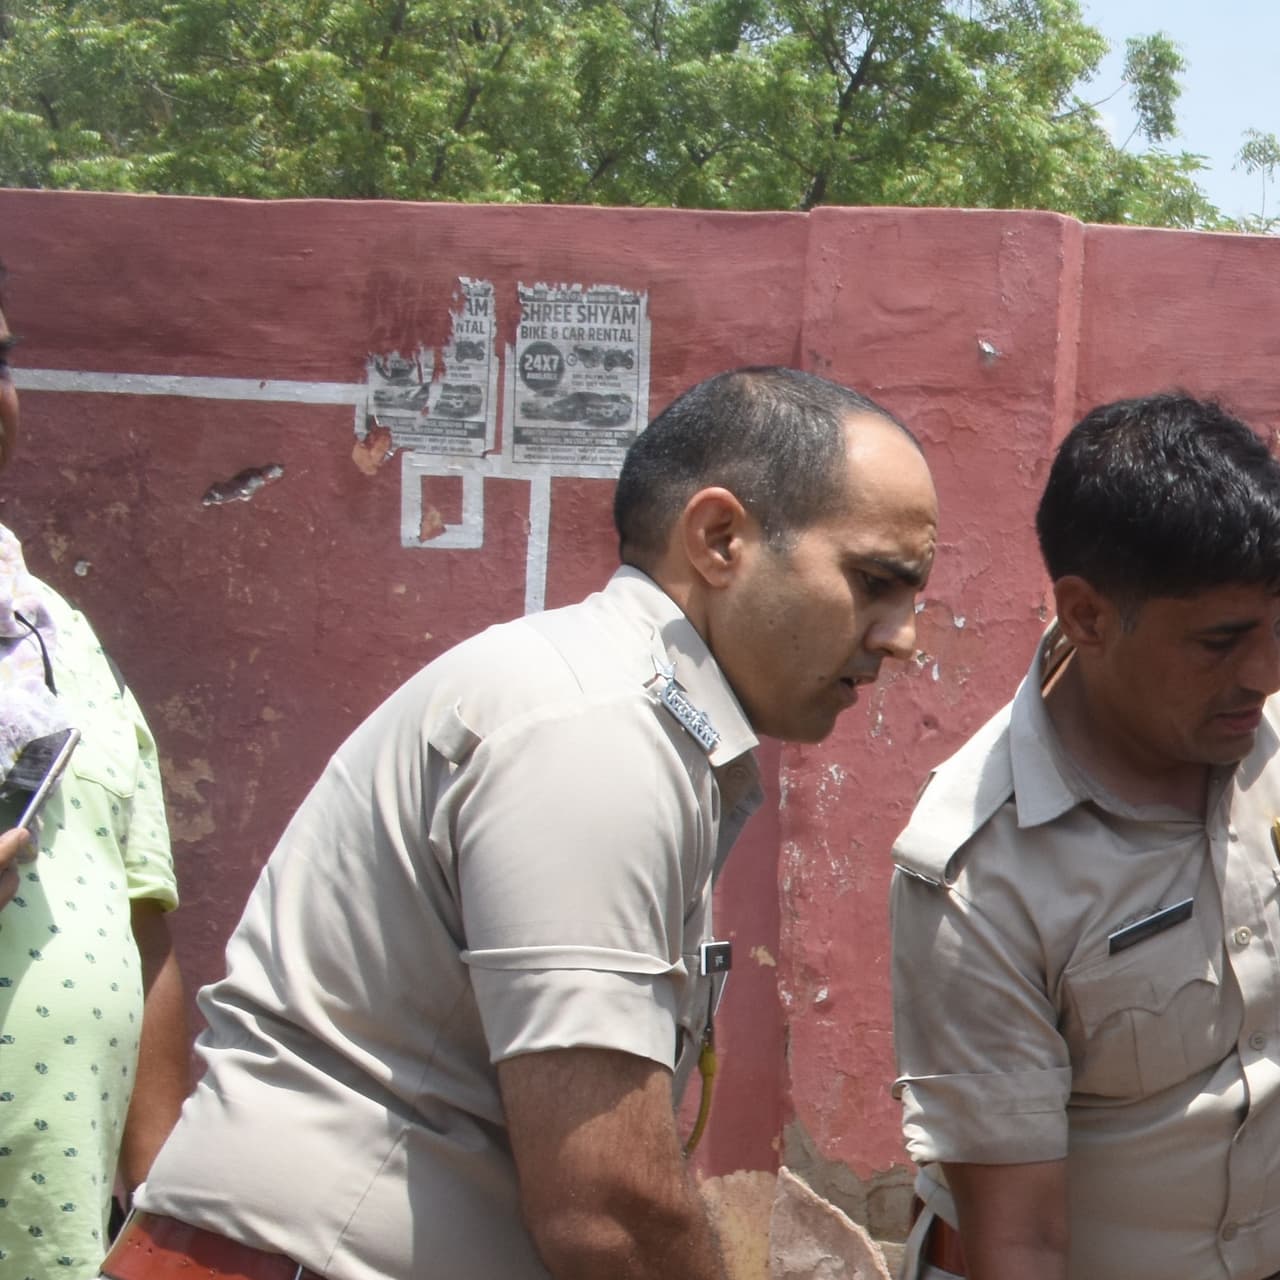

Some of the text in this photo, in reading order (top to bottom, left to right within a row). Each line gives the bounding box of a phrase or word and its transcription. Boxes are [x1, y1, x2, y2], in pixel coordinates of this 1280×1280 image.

[521, 303, 637, 326] SHREE SHYAM
[521, 325, 548, 340] BIKE
[562, 327, 585, 341] CAR
[588, 328, 634, 343] RENTAL
[524, 354, 560, 372] 24X7
